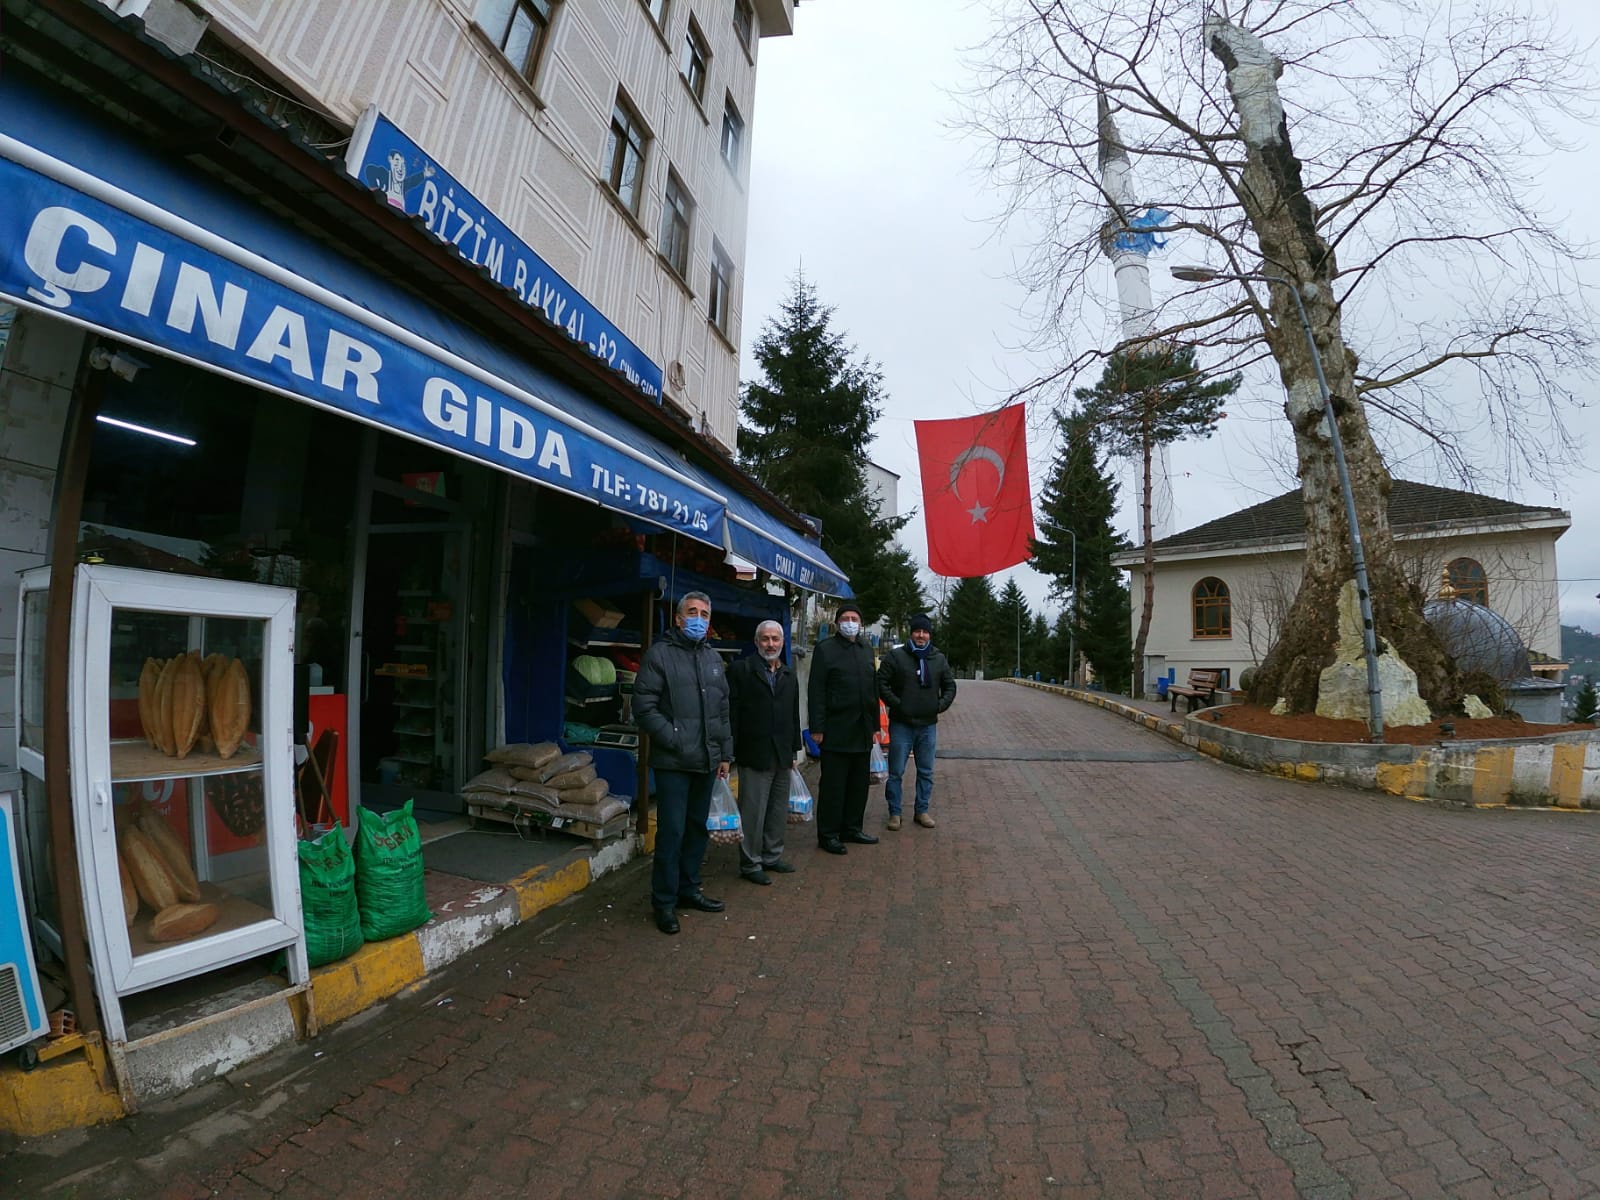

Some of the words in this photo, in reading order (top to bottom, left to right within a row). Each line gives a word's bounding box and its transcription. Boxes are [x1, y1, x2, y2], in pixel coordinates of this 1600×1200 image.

[418, 180, 505, 284] BİZİM
[24, 206, 382, 404] ÇINAR
[421, 376, 572, 479] GIDA
[591, 463, 631, 502] TLF:
[637, 483, 668, 512] 787
[672, 499, 690, 523] 21
[692, 510, 709, 532] 05
